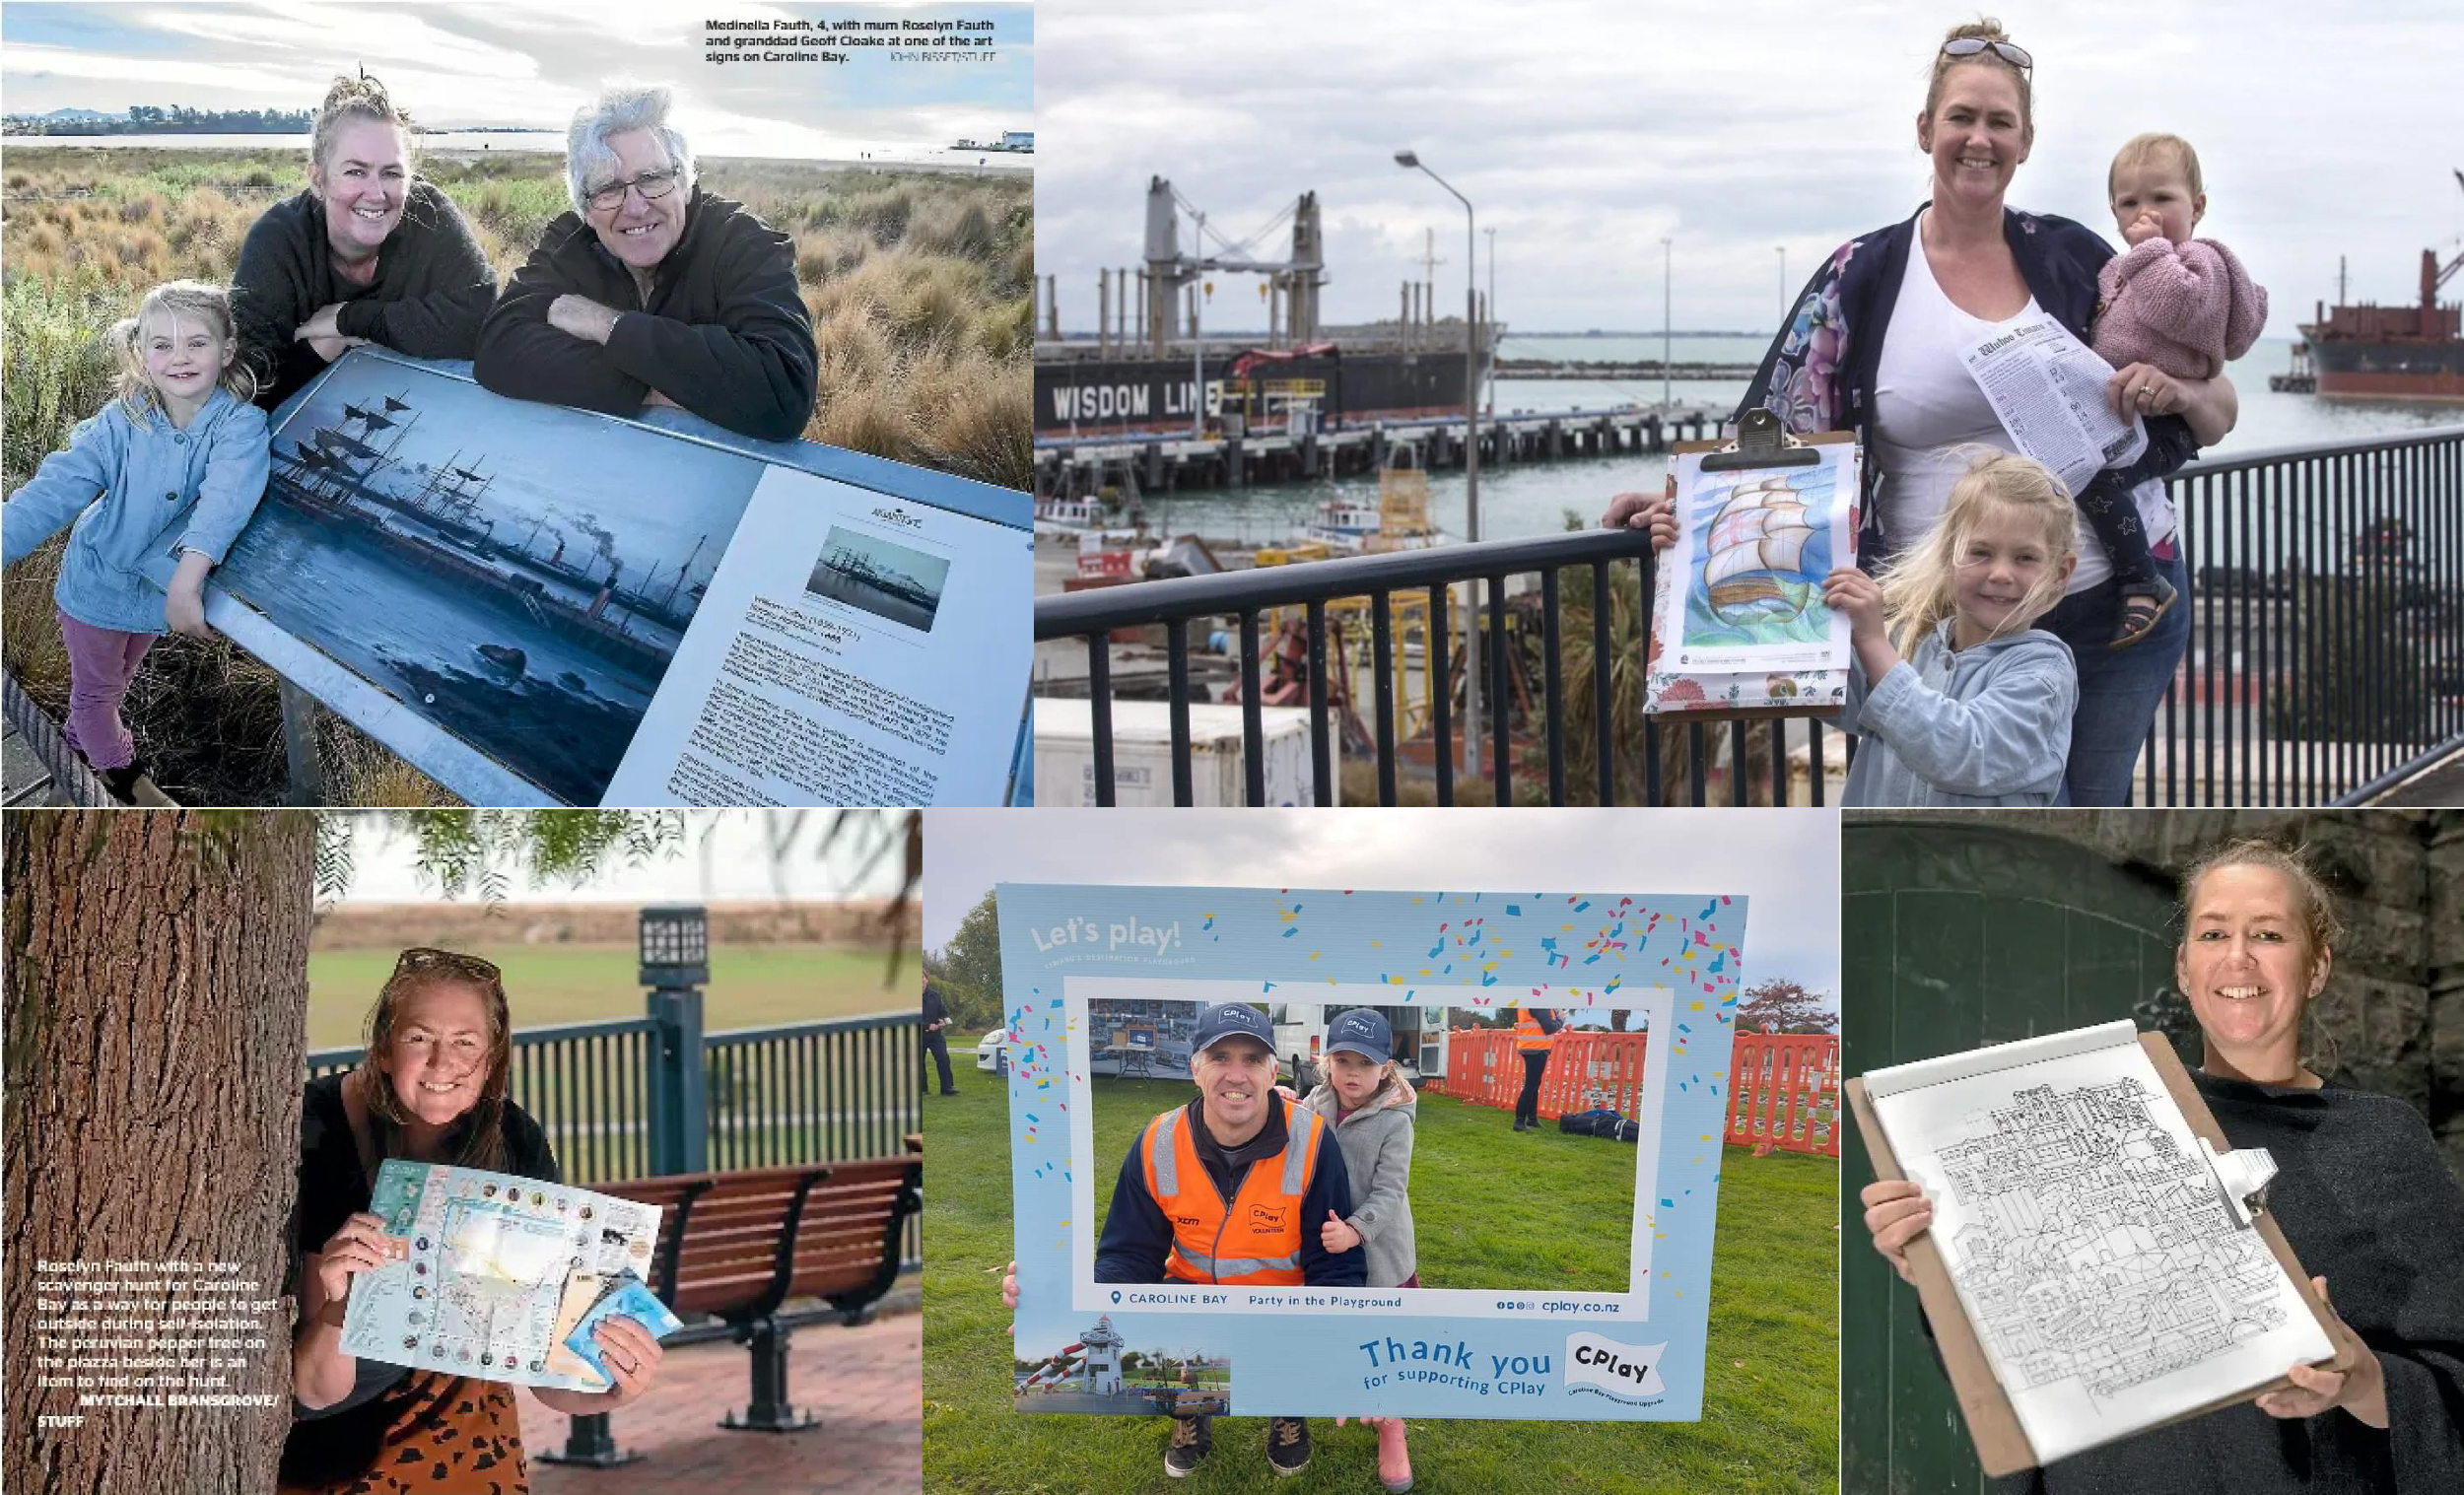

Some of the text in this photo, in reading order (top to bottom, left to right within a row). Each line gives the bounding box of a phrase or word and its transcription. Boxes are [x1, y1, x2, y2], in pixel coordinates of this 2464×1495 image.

[1053, 380, 1221, 420] WISDOM LINE
[1031, 917, 1182, 956] Let's play!
[1223, 1009, 1252, 1023] CPlay
[1129, 1293, 1619, 1315] CAROLINE BAY Party in the Playground cplay.co.nz
[1359, 1336, 1551, 1380] Thank you
[1575, 1345, 1649, 1384] CPlay
[1364, 1367, 1545, 1396] for supporting CPlay
[1568, 1387, 1664, 1408] Caroline Bay Playground Upgrade
